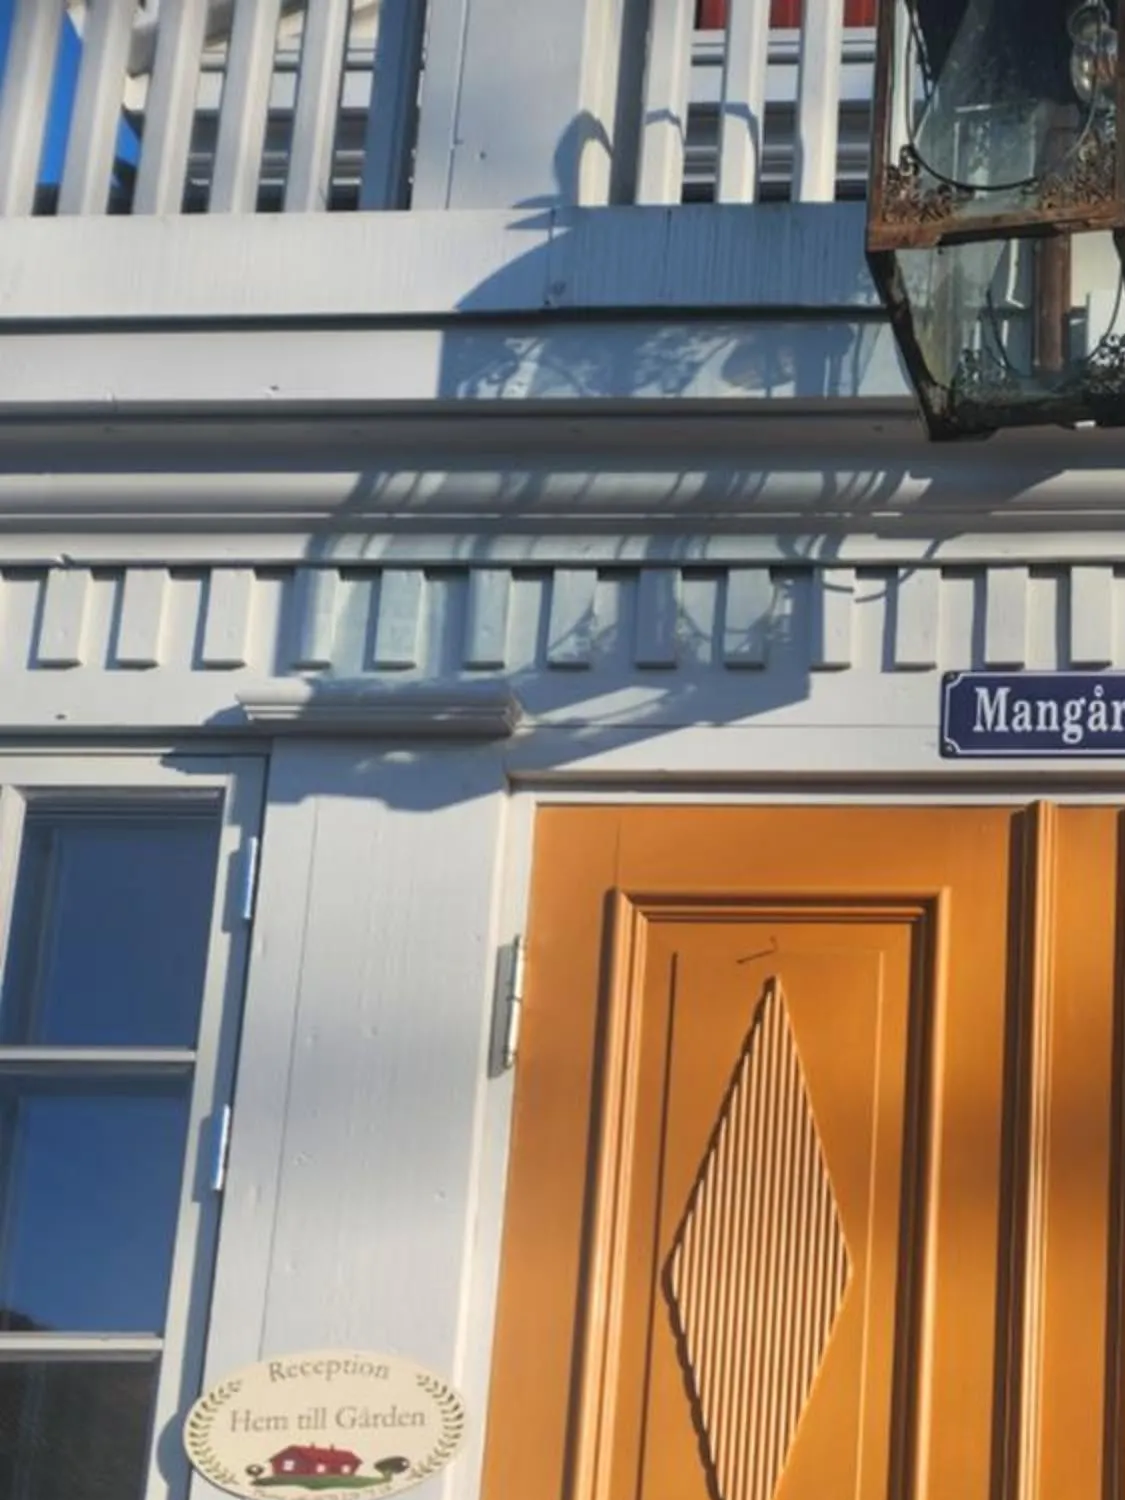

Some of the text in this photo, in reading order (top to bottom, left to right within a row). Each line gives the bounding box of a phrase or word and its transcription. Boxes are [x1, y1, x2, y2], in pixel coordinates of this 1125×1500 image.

[269, 1355, 390, 1382] Reception
[229, 1403, 426, 1433] Hem till Gården
